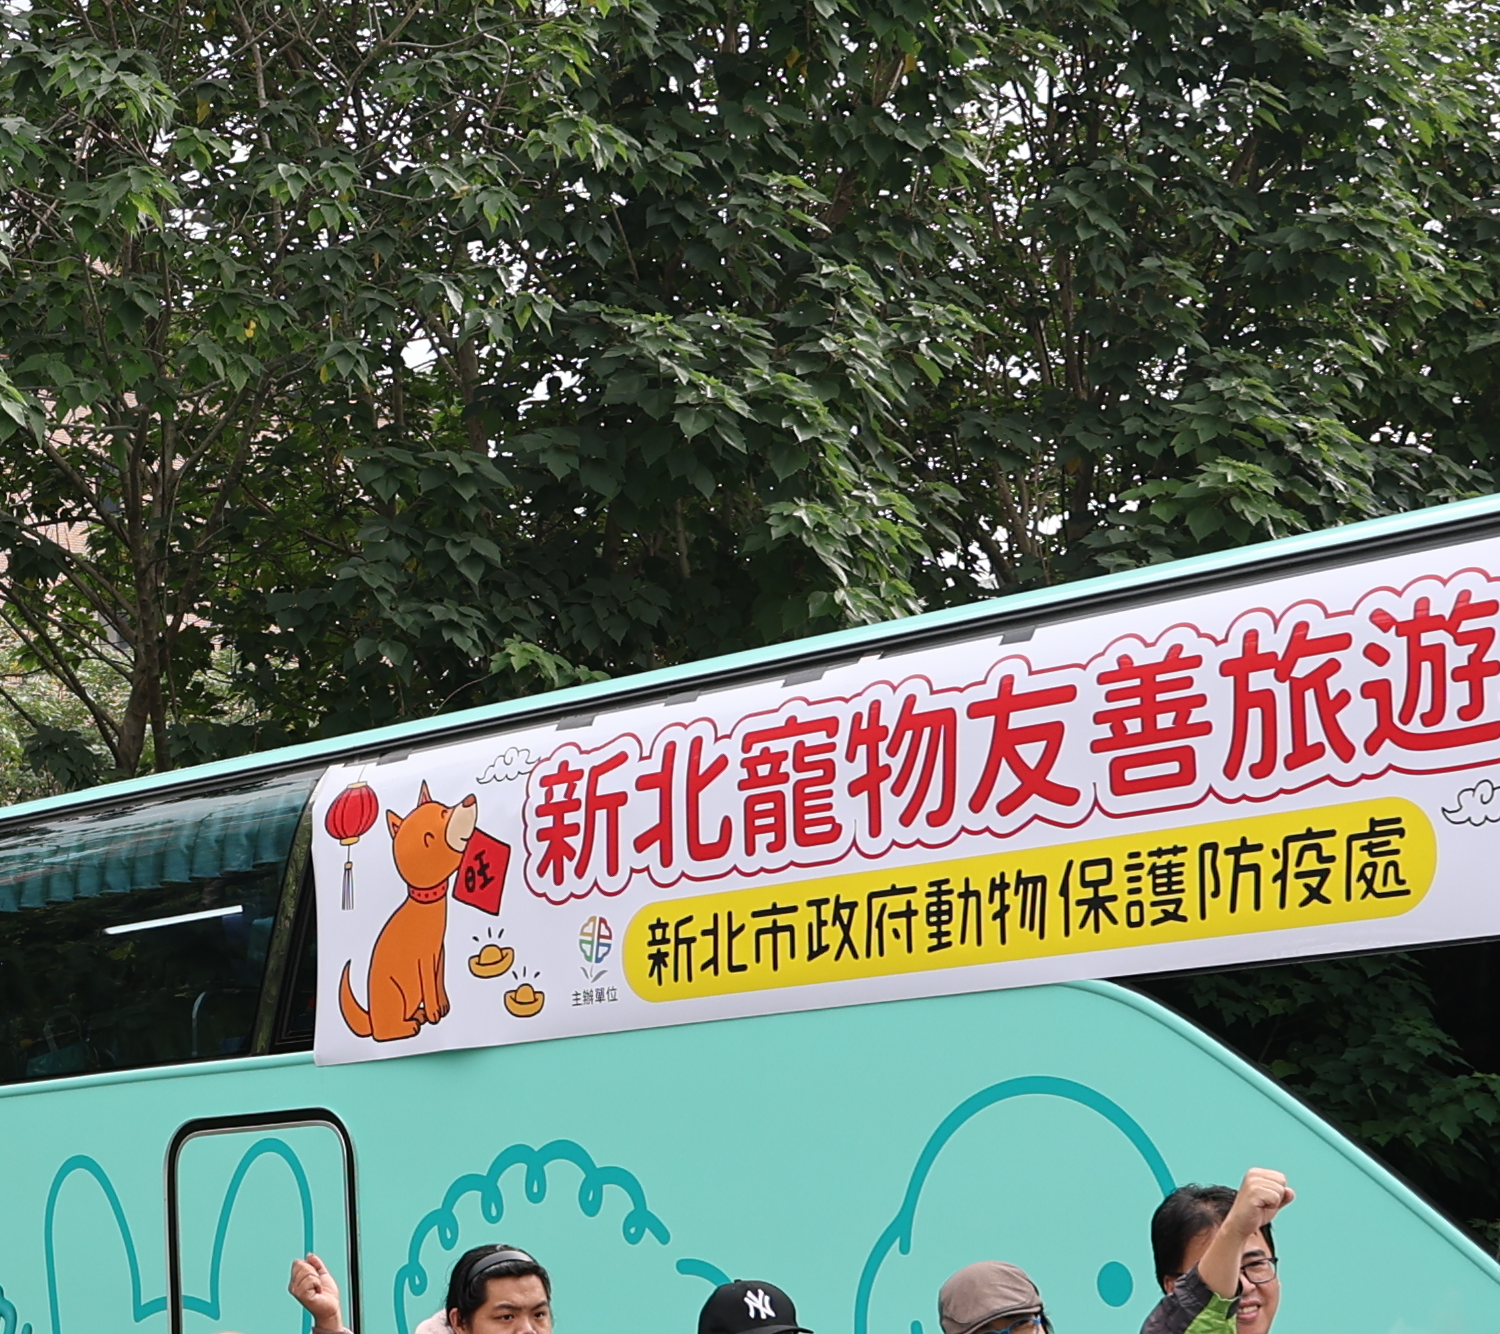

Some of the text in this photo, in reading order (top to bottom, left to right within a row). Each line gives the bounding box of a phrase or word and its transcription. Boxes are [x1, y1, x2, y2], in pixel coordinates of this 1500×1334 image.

[464, 849, 495, 893] 旺
[647, 816, 1412, 987] 新北市政府動物保護防疫處
[571, 986, 618, 1007] 主辦單位
[743, 1288, 776, 1319] NY
